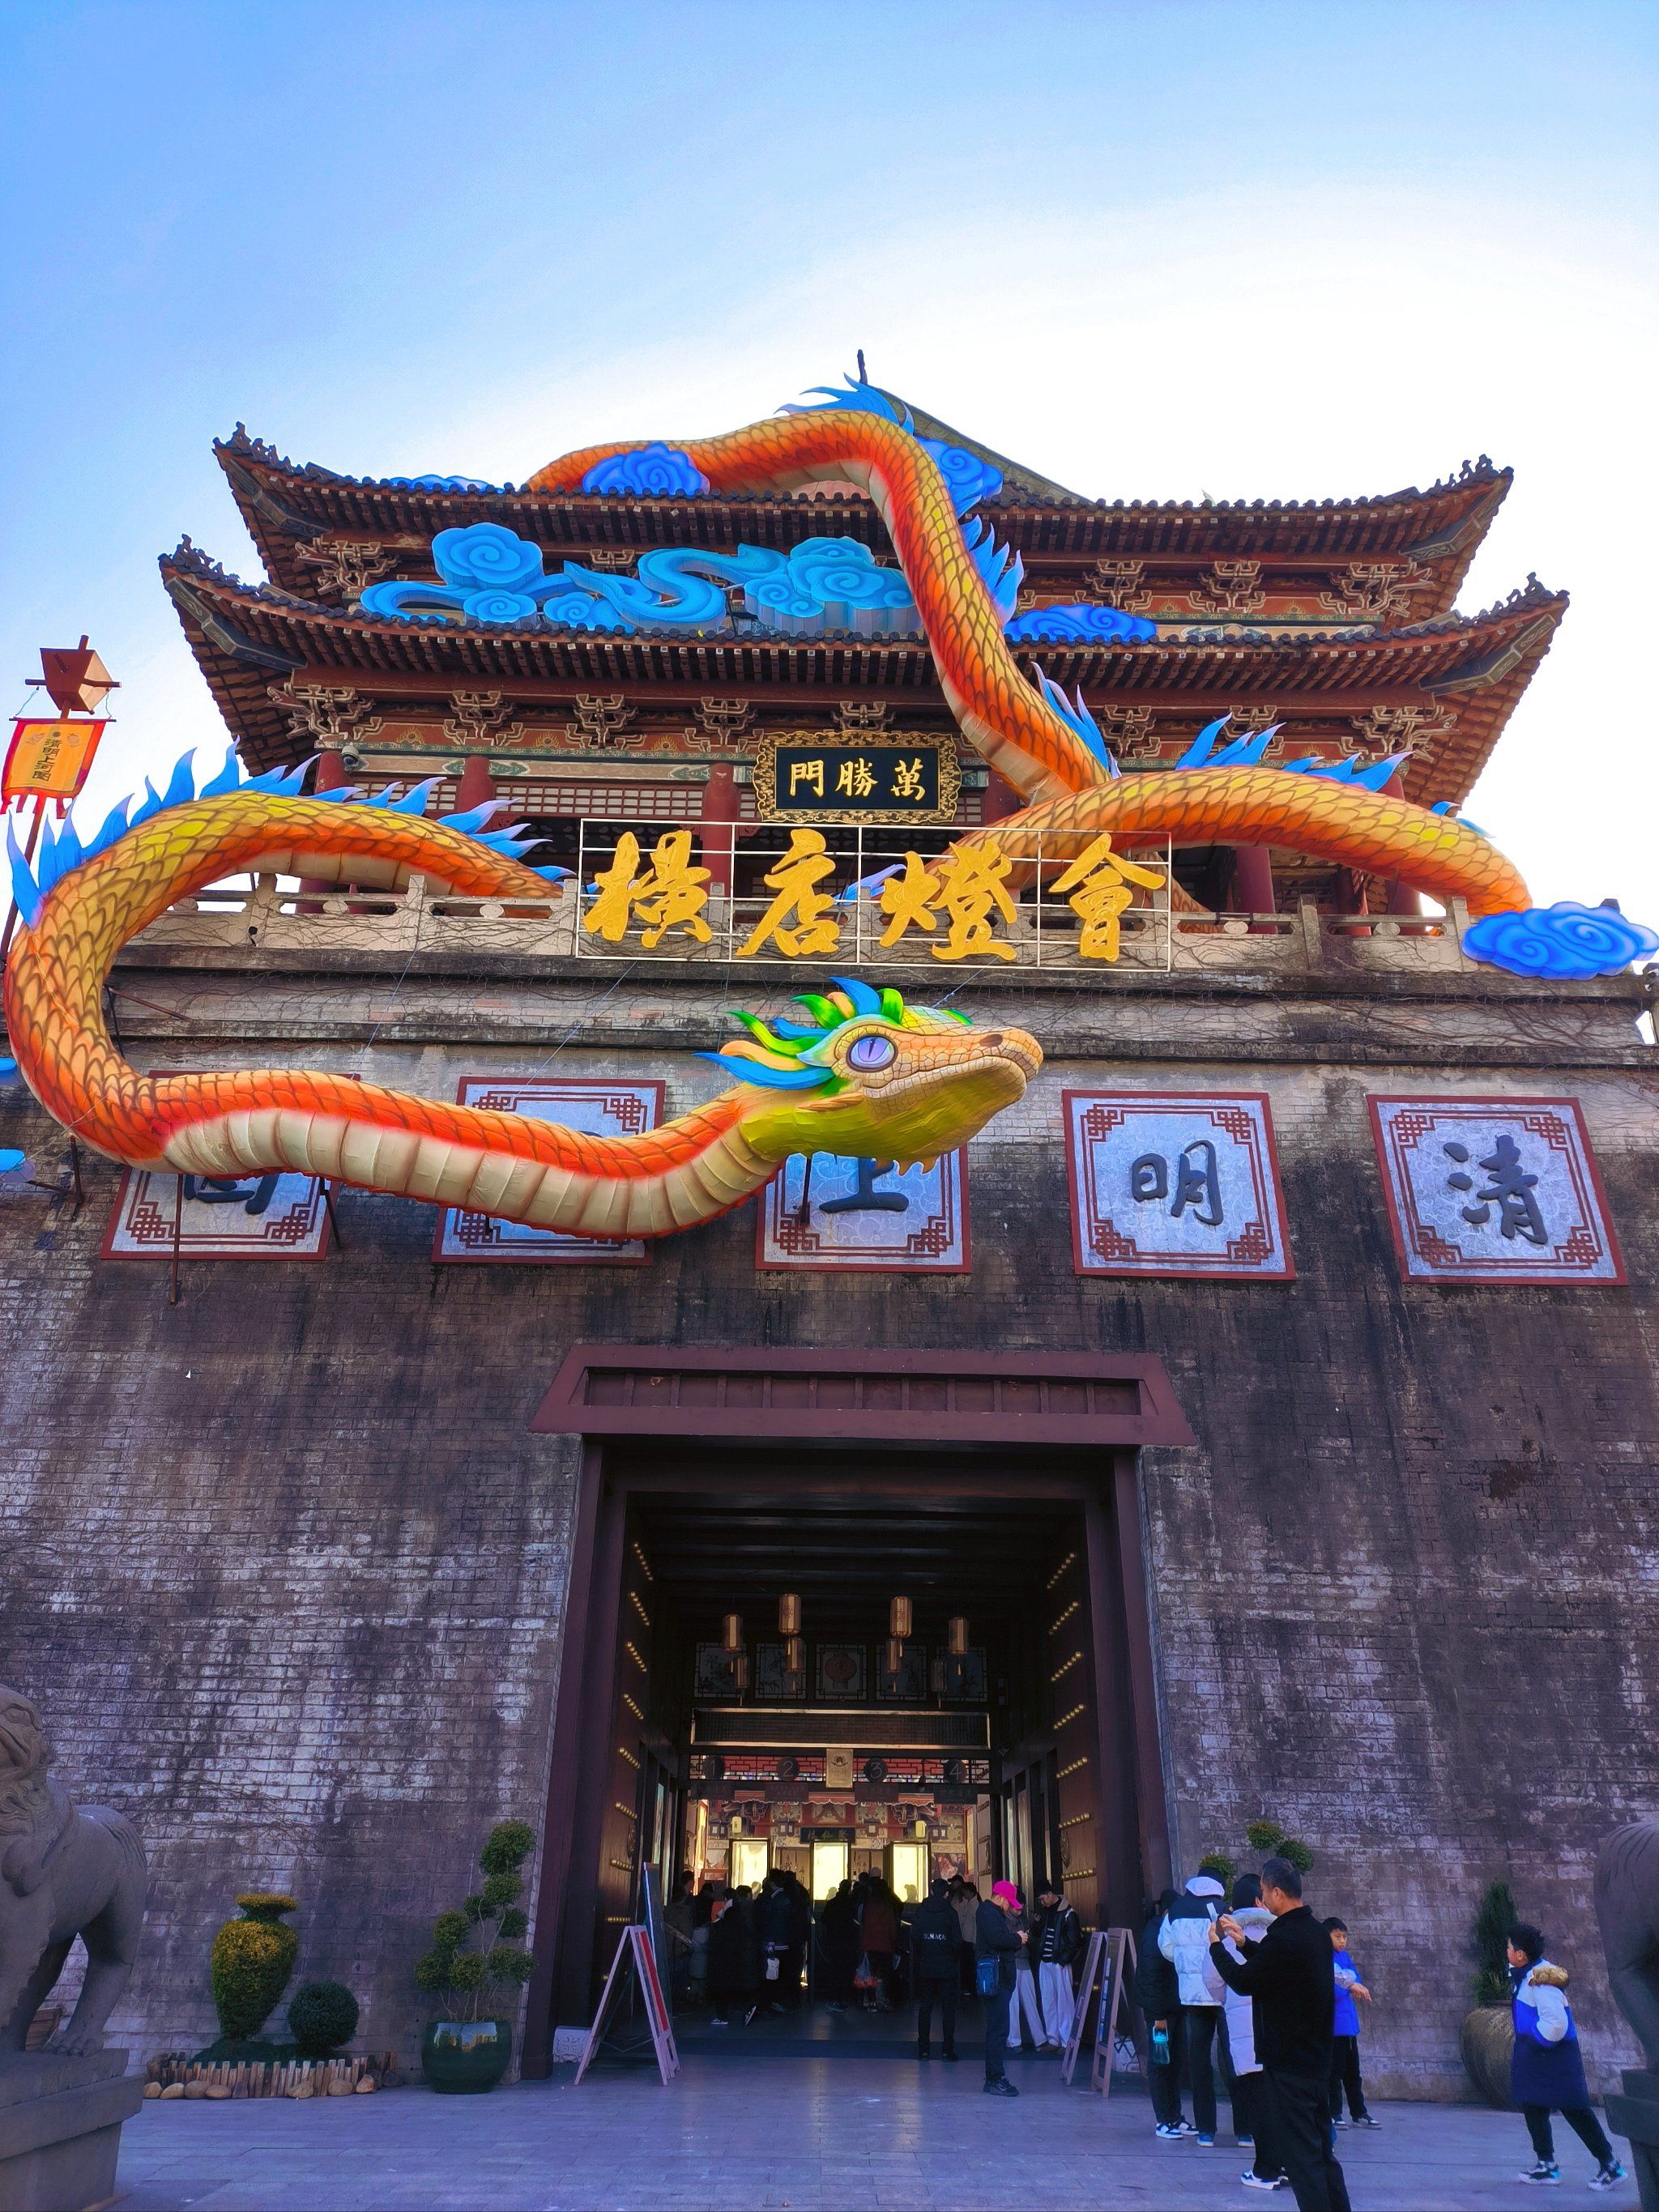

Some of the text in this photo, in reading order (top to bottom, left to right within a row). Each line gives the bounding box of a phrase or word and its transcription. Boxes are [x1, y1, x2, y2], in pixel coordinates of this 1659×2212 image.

[32, 739, 63, 782] 清明上河圖
[790, 757, 926, 801] 萬勝門
[1132, 1140, 1224, 1225] 明
[1444, 1135, 1548, 1244] 清
[783, 1760, 794, 1778] 2
[871, 1761, 883, 1779] 3
[949, 1763, 962, 1779] 4
